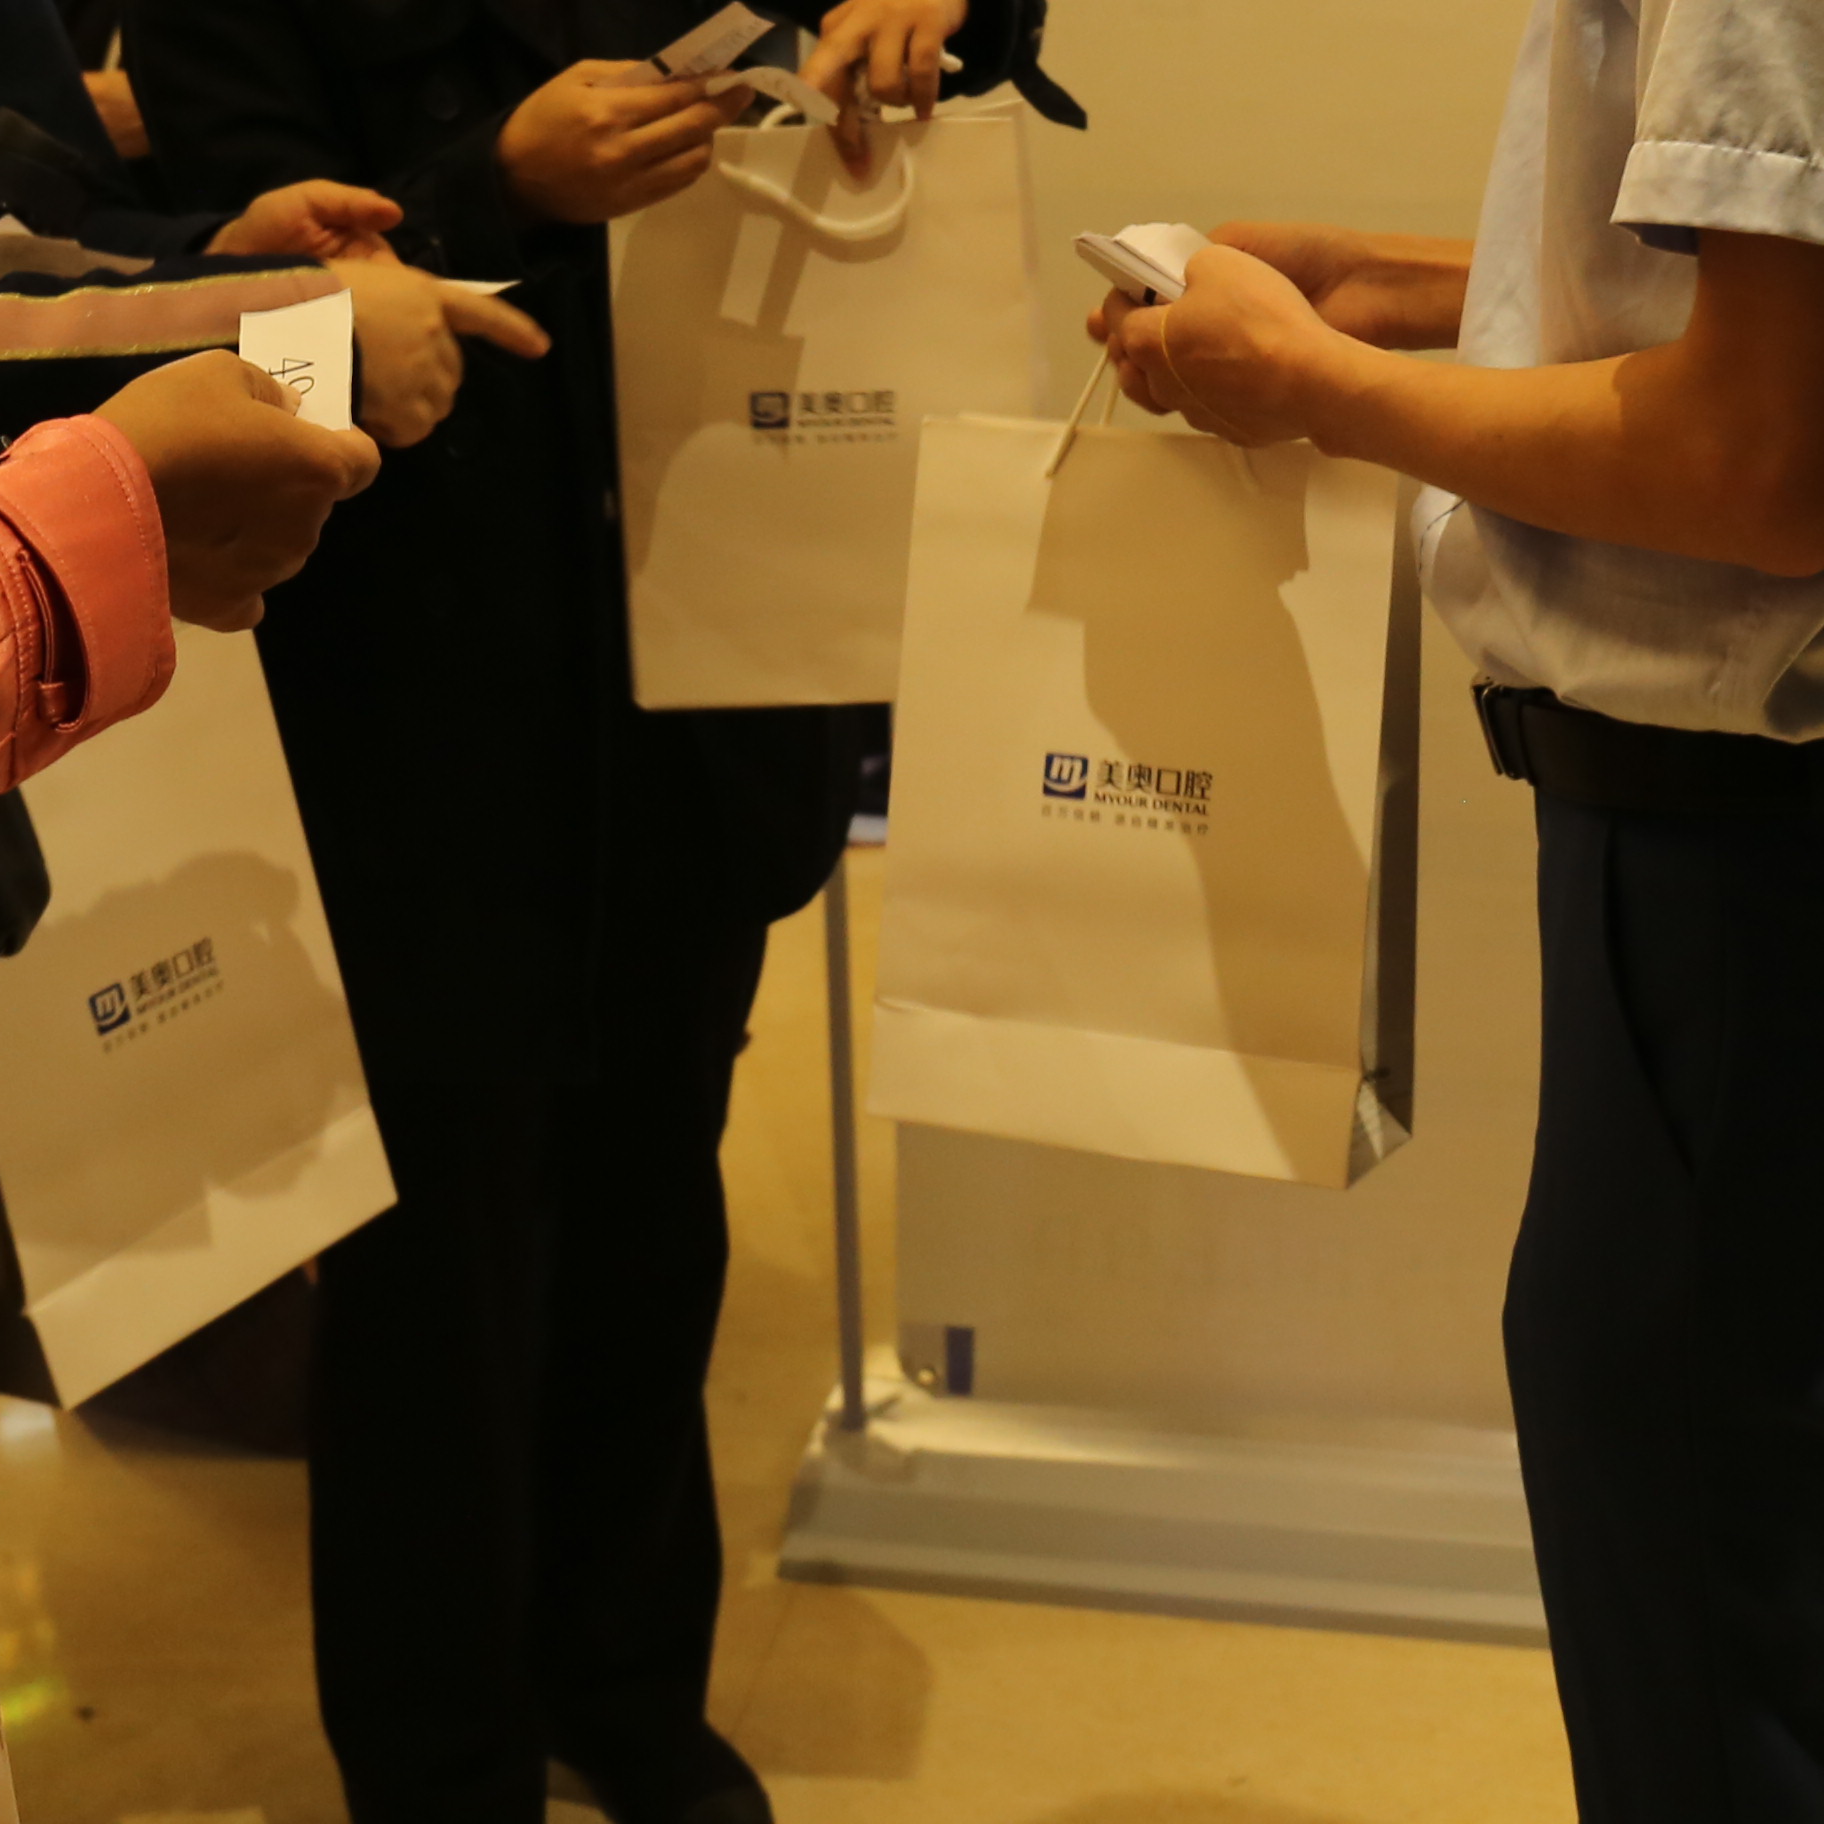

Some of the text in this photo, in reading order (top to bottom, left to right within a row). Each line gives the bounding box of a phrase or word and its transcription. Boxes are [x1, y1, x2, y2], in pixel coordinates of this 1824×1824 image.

[1097, 758, 1214, 801] 美奥口腔
[1094, 791, 1210, 817] MYOUR DENTAL
